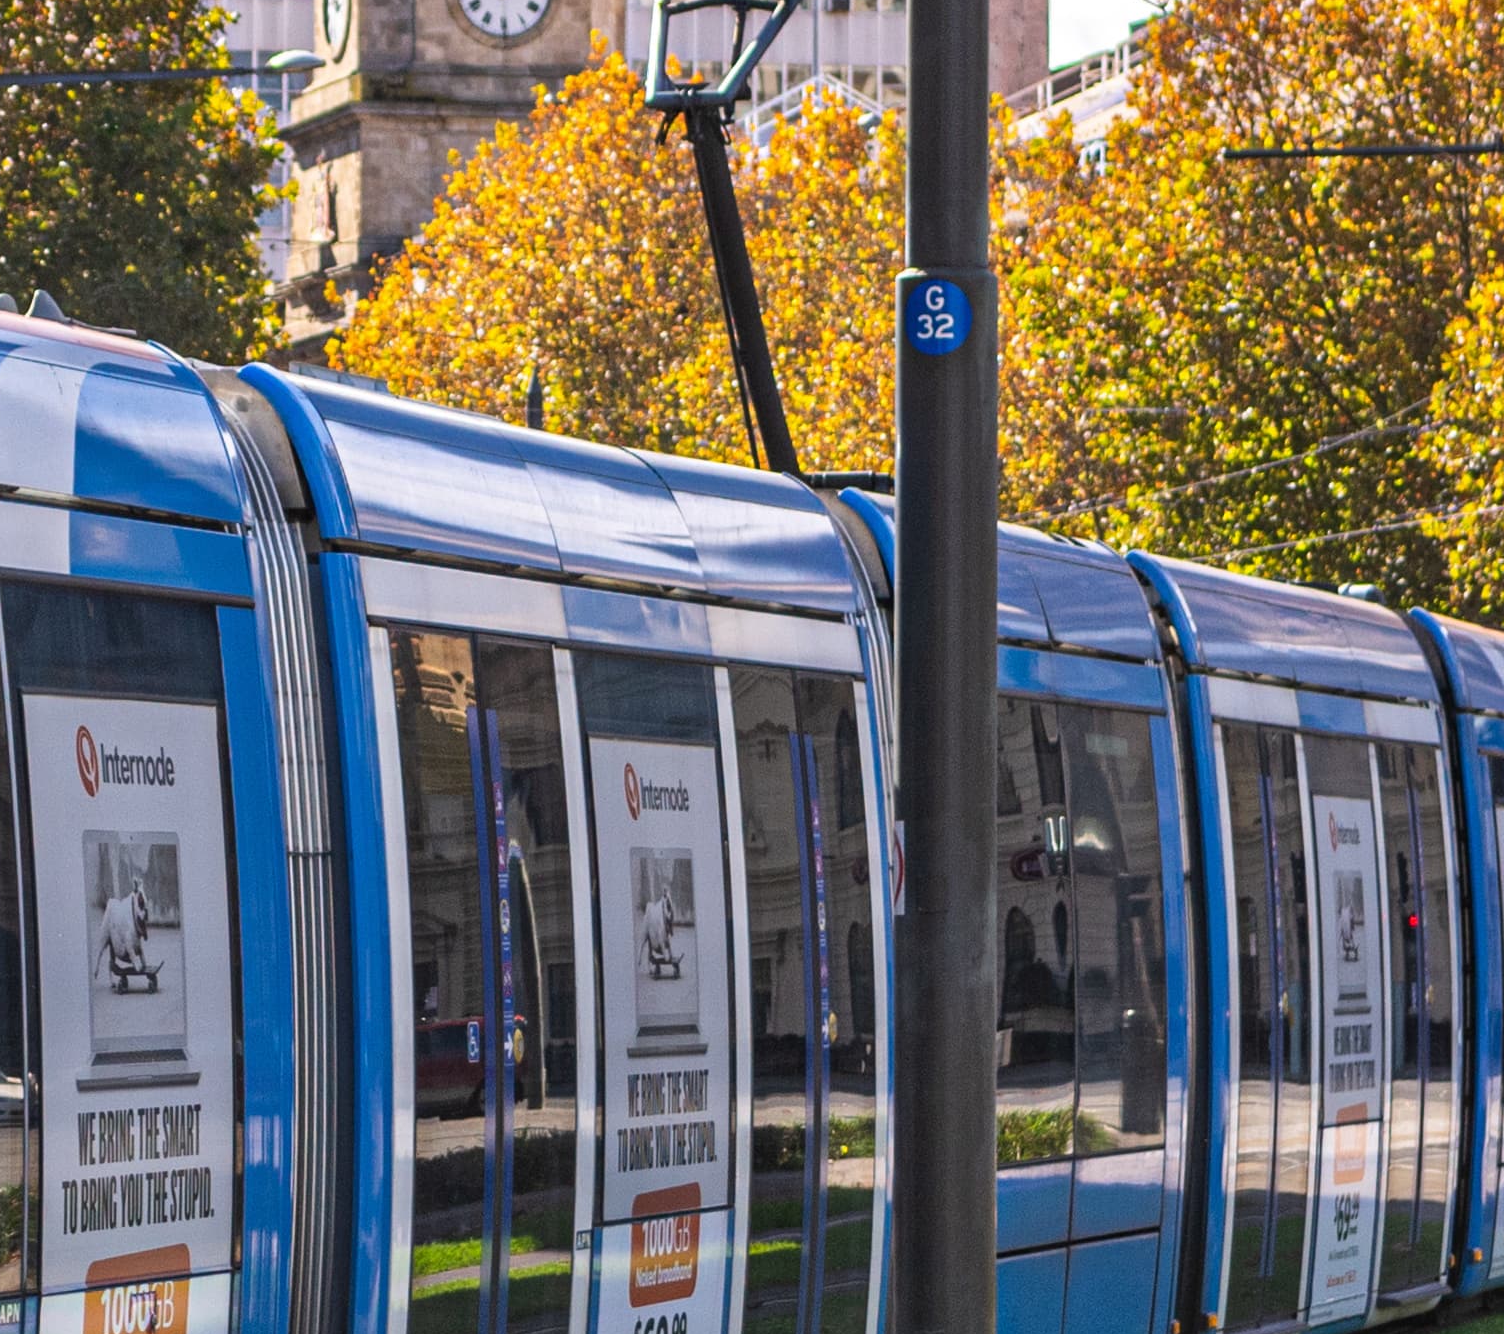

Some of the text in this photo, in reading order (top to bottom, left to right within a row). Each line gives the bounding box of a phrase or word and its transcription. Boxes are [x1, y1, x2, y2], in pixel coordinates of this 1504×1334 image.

[926, 285, 945, 311] G
[917, 313, 954, 339] 32
[100, 743, 175, 786] Internode
[639, 777, 689, 811] Internode
[628, 1069, 709, 1118] WE BRING THE SMART
[78, 1104, 201, 1166] WE BRING THE SMART
[617, 1128, 628, 1173] TO
[629, 1126, 653, 1171] BRING
[655, 1124, 671, 1168] YOU
[672, 1123, 686, 1166] THE
[62, 1167, 215, 1235] TO BRING YOU THE STUPID.
[643, 1217, 691, 1258] 1000GB
